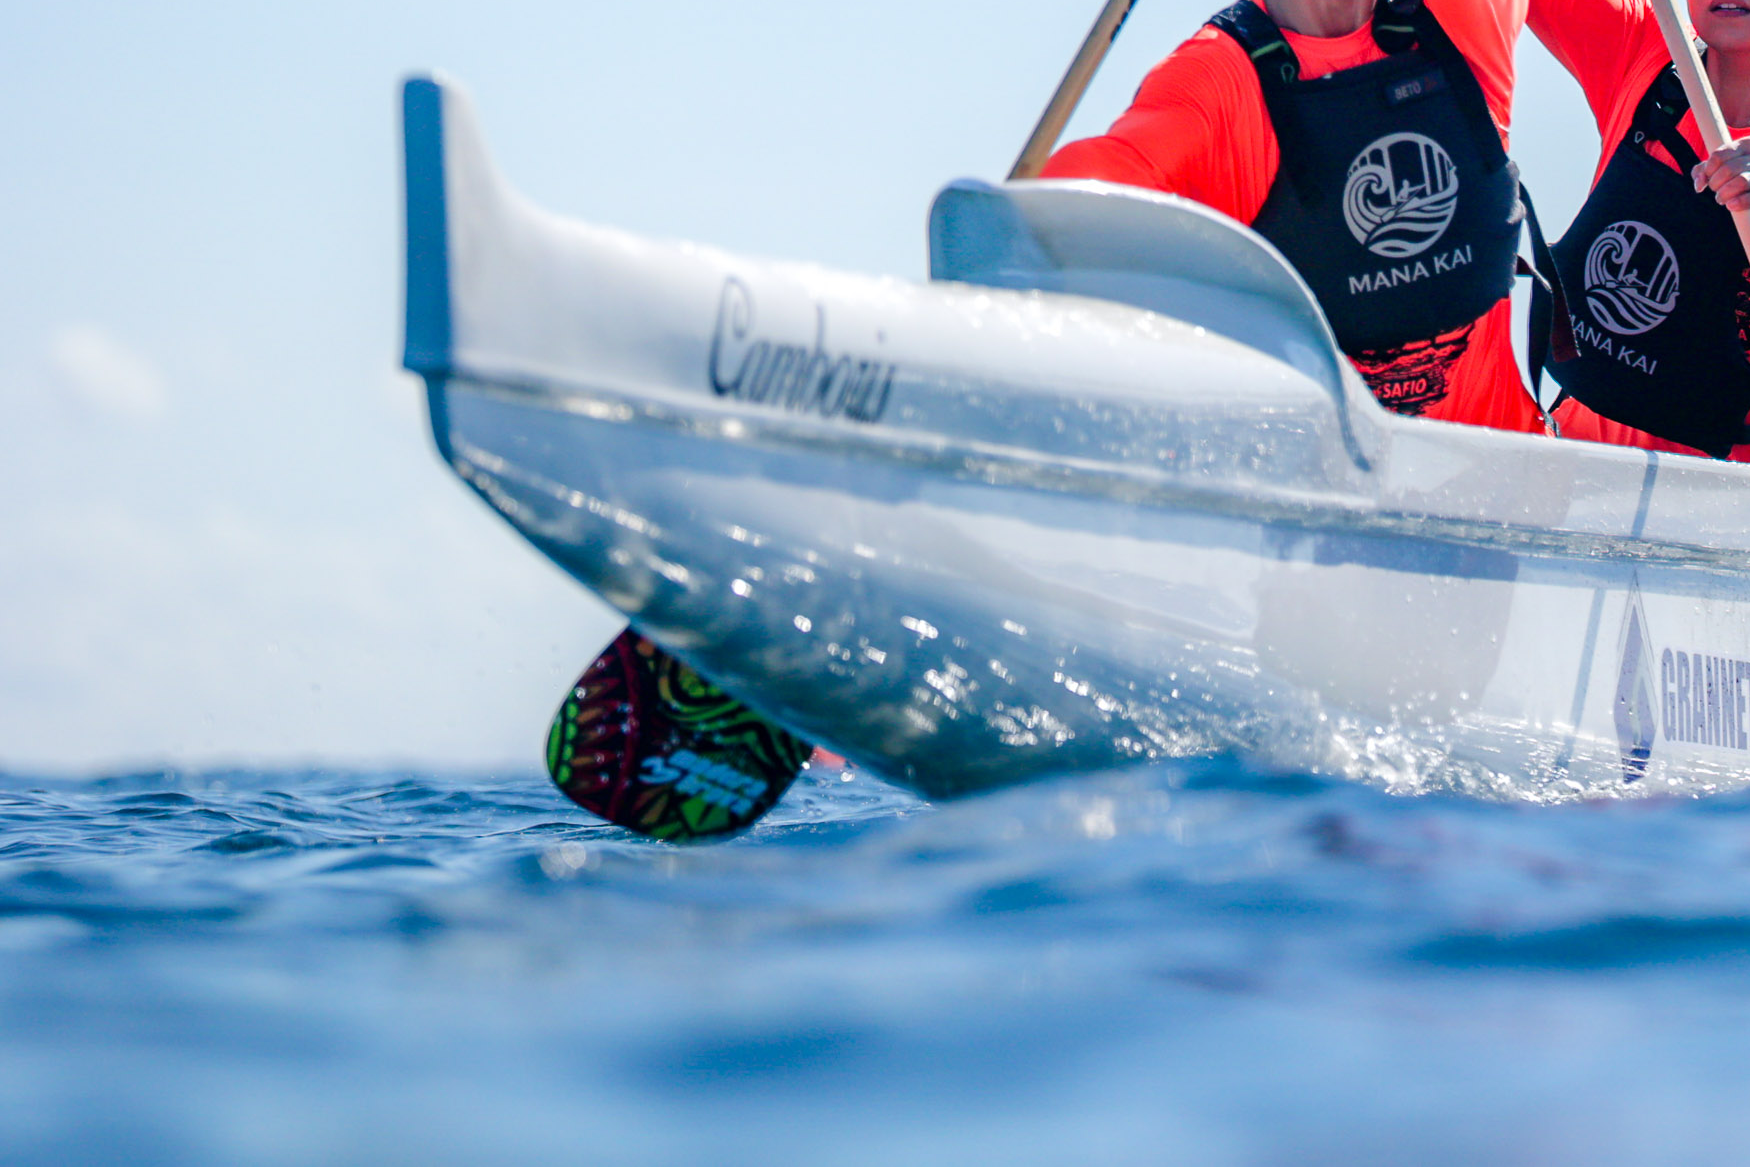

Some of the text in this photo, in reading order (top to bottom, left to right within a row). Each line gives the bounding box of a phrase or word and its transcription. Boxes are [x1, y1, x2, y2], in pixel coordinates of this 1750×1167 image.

[1348, 244, 1473, 295] MANA KAI
[1617, 345, 1657, 375] KAI
[1374, 377, 1427, 399] SAFIO
